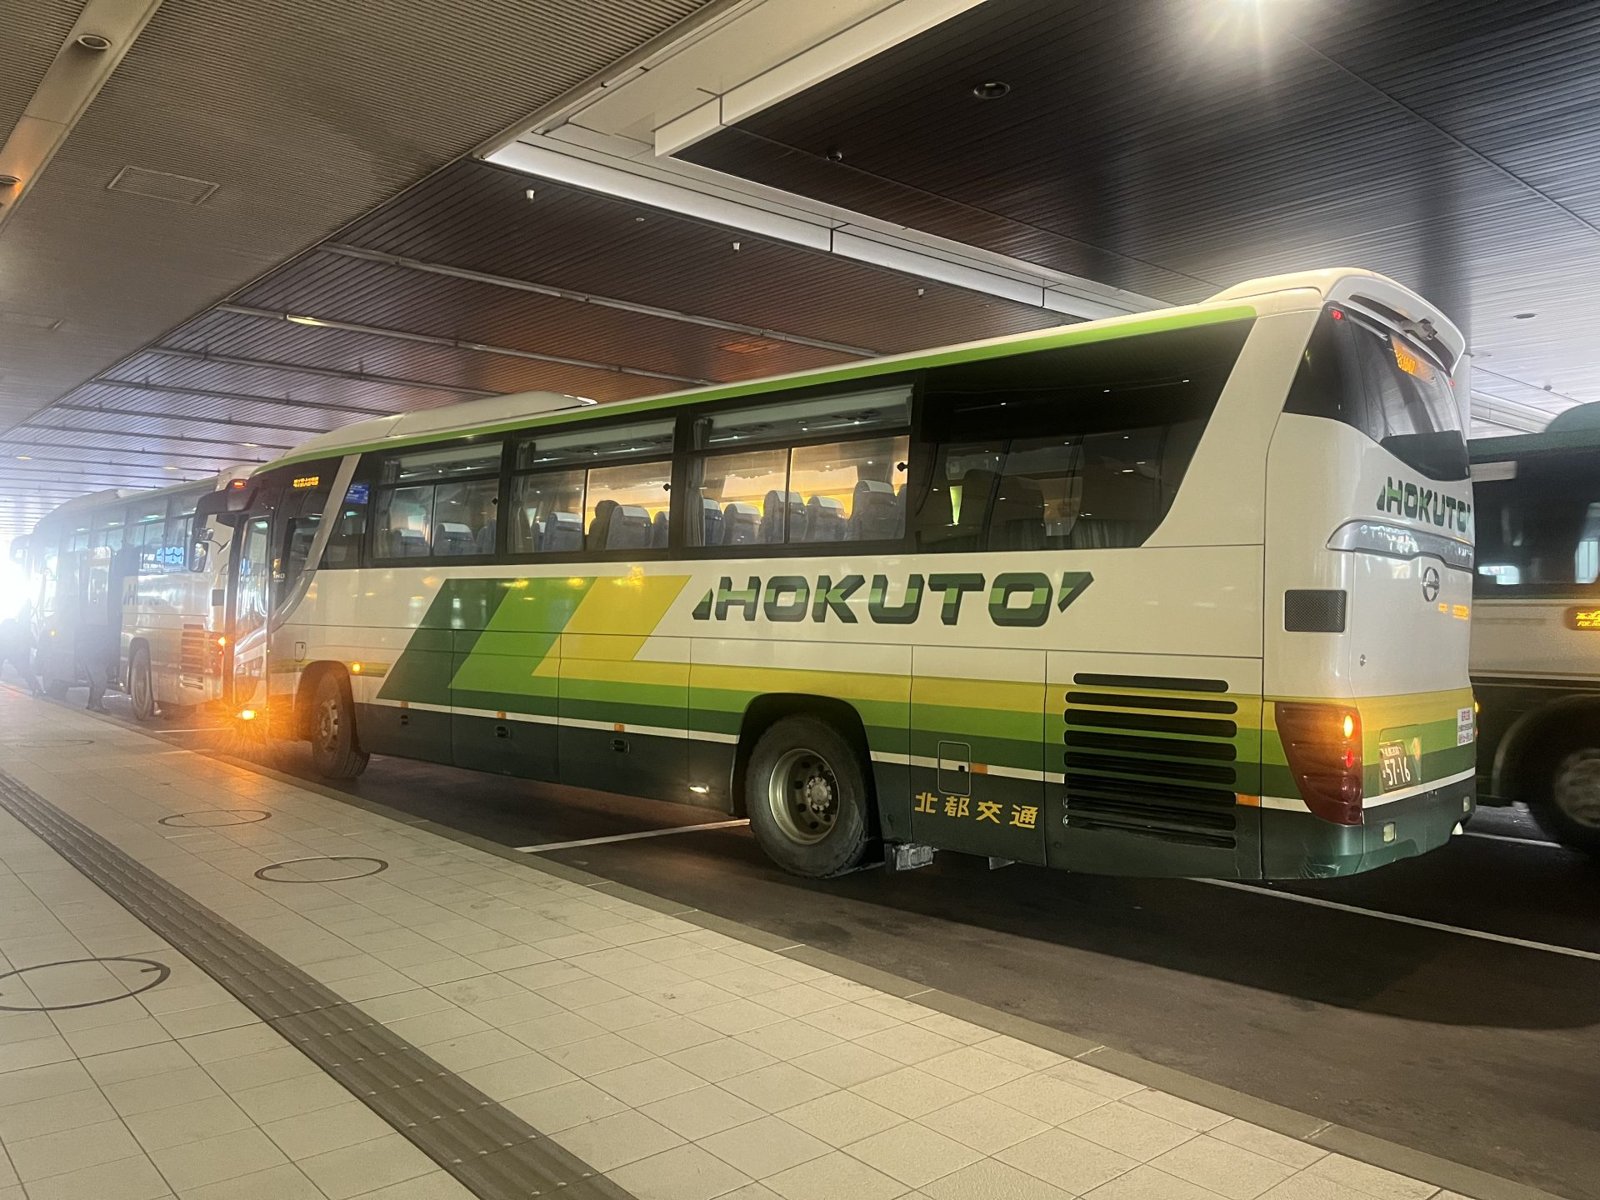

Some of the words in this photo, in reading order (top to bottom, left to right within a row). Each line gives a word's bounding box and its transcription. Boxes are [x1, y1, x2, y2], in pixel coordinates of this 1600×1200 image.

[1386, 476, 1467, 533] HOKUTO
[714, 571, 1054, 628] HOKUTO
[914, 791, 1039, 829] 北都交通
